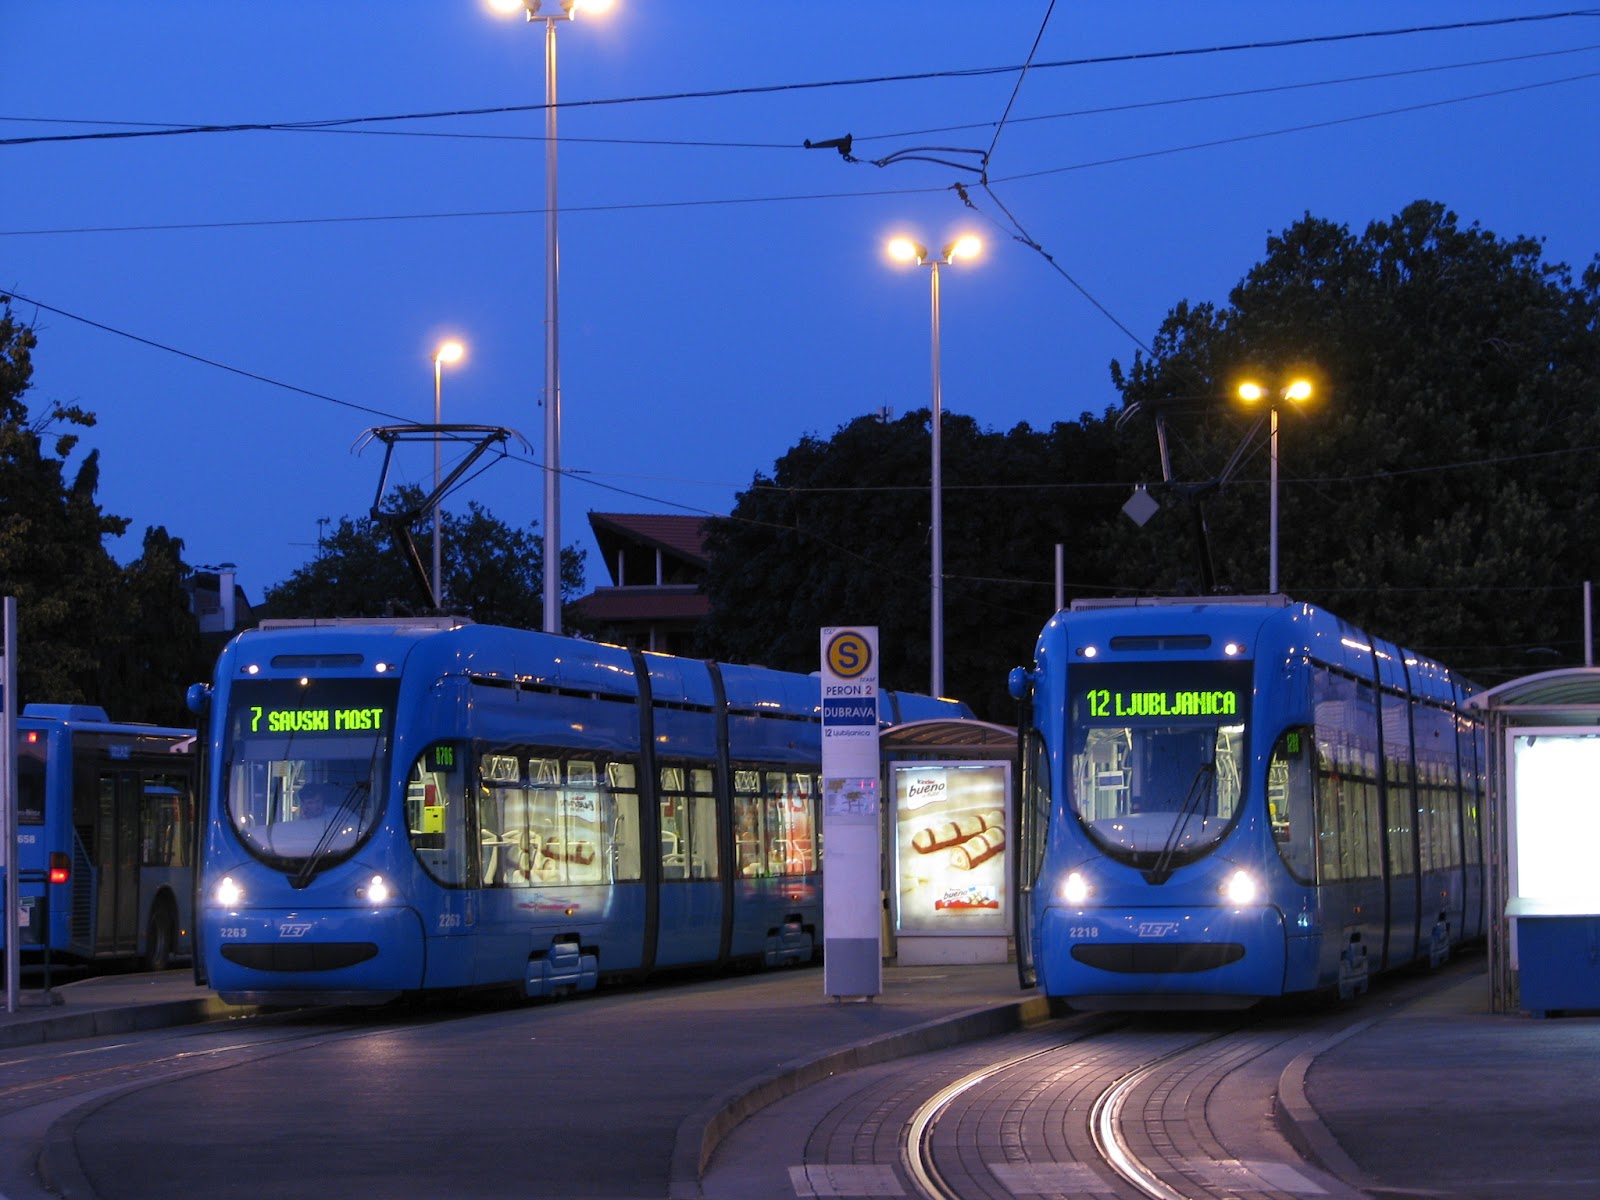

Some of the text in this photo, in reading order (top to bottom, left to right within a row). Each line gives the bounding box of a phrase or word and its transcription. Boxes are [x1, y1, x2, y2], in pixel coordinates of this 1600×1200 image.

[838, 641, 860, 668] S
[826, 685, 872, 696] PERON 2
[1086, 689, 1236, 717] 12 LJUBLJANICA
[250, 706, 384, 732] 7 SAVSKI MOST
[824, 706, 875, 718] DUBRAVA
[825, 728, 871, 738] 12 Ljubljanica
[909, 782, 946, 798] bueno
[943, 890, 968, 900] bueno
[439, 913, 461, 928] 2263
[220, 927, 247, 938] 2263
[279, 923, 312, 938] ZET
[1069, 926, 1099, 938] 2218
[1138, 922, 1175, 938] ZET
